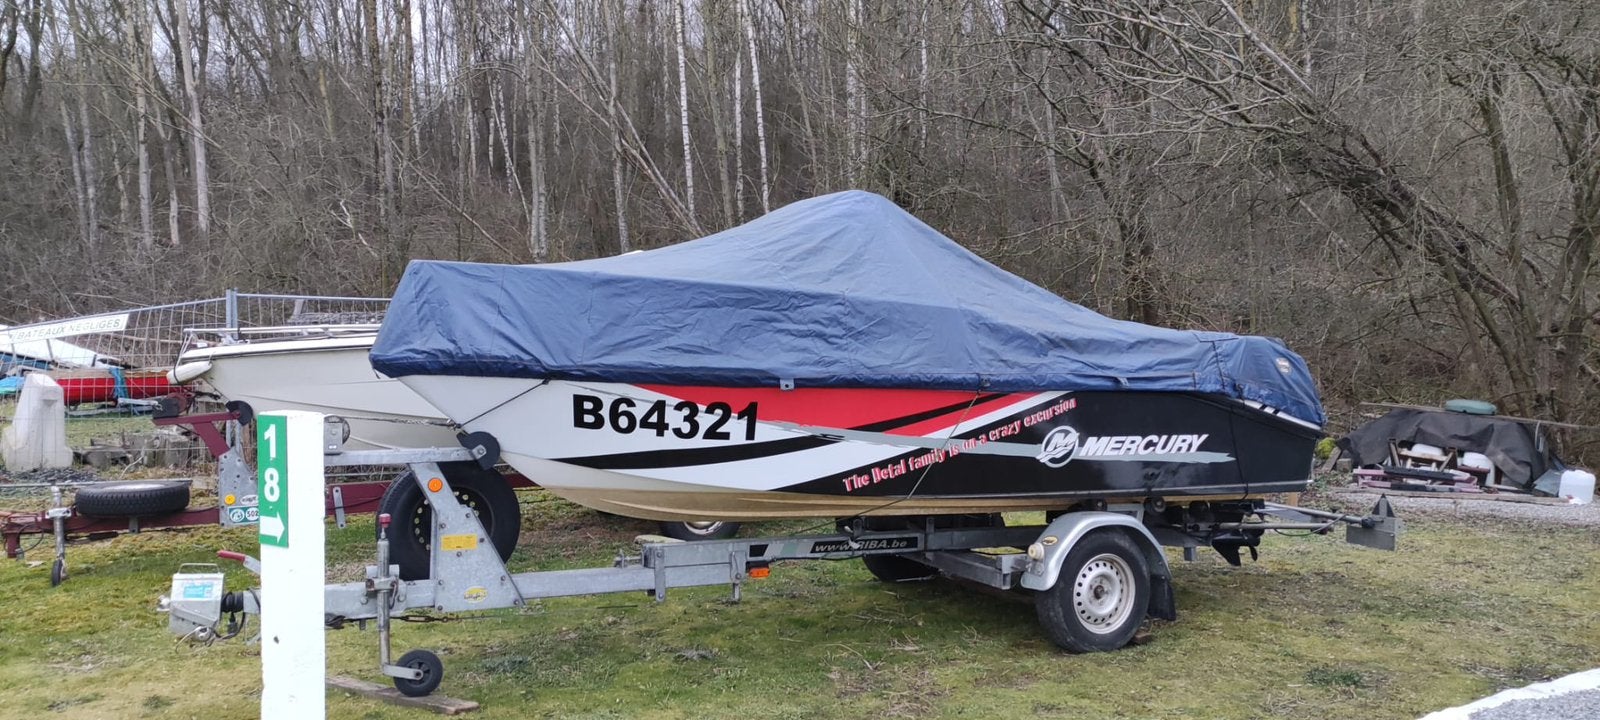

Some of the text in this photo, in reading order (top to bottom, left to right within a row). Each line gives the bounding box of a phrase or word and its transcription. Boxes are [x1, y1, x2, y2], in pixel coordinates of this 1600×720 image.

[572, 394, 759, 441] B64321
[843, 473, 871, 492] The
[908, 447, 947, 472] family
[948, 442, 960, 458] is
[961, 437, 977, 450] on
[978, 433, 989, 445] a
[988, 419, 1022, 441] crazy
[1023, 397, 1078, 428] excursion
[1078, 433, 1210, 457] MERCURY
